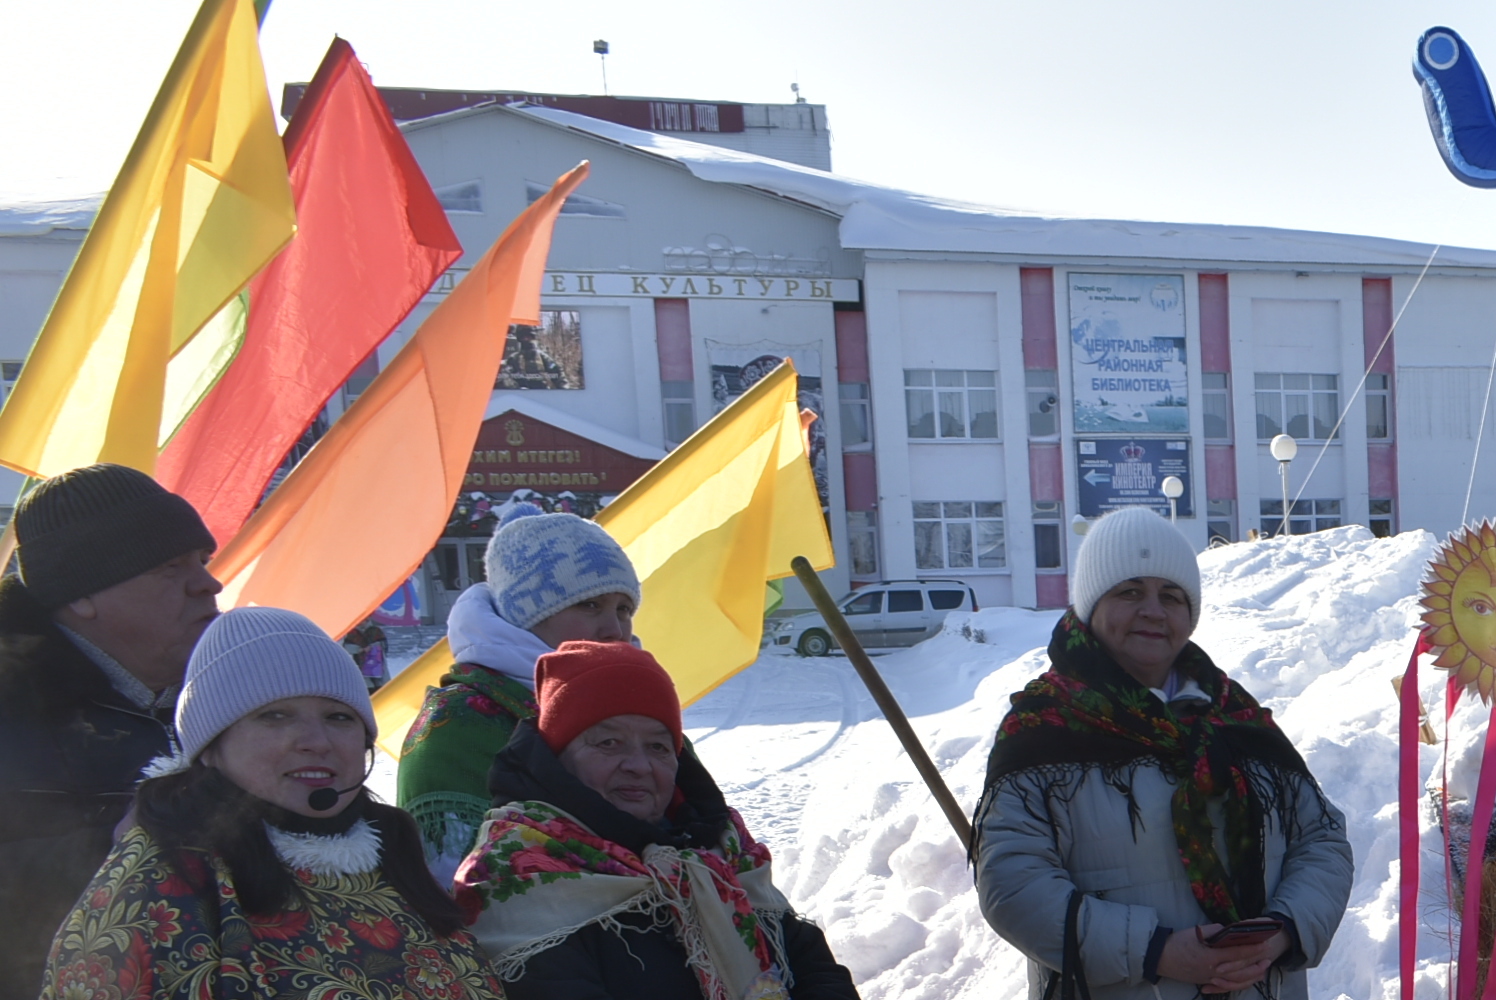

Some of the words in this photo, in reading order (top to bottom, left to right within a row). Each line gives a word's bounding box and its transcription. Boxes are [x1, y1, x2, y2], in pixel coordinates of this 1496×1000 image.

[631, 276, 833, 298] КУЛЬТУРЫ
[1086, 338, 1174, 355] ЦЕНТРАЛЬНАЯ
[1098, 357, 1164, 373] РАЙОННАЯ
[1091, 378, 1172, 392] БИБЛИОТЕКА
[1115, 462, 1153, 476] ИМПЕРИЯ
[1112, 476, 1157, 489] КИНОТЕАТР
